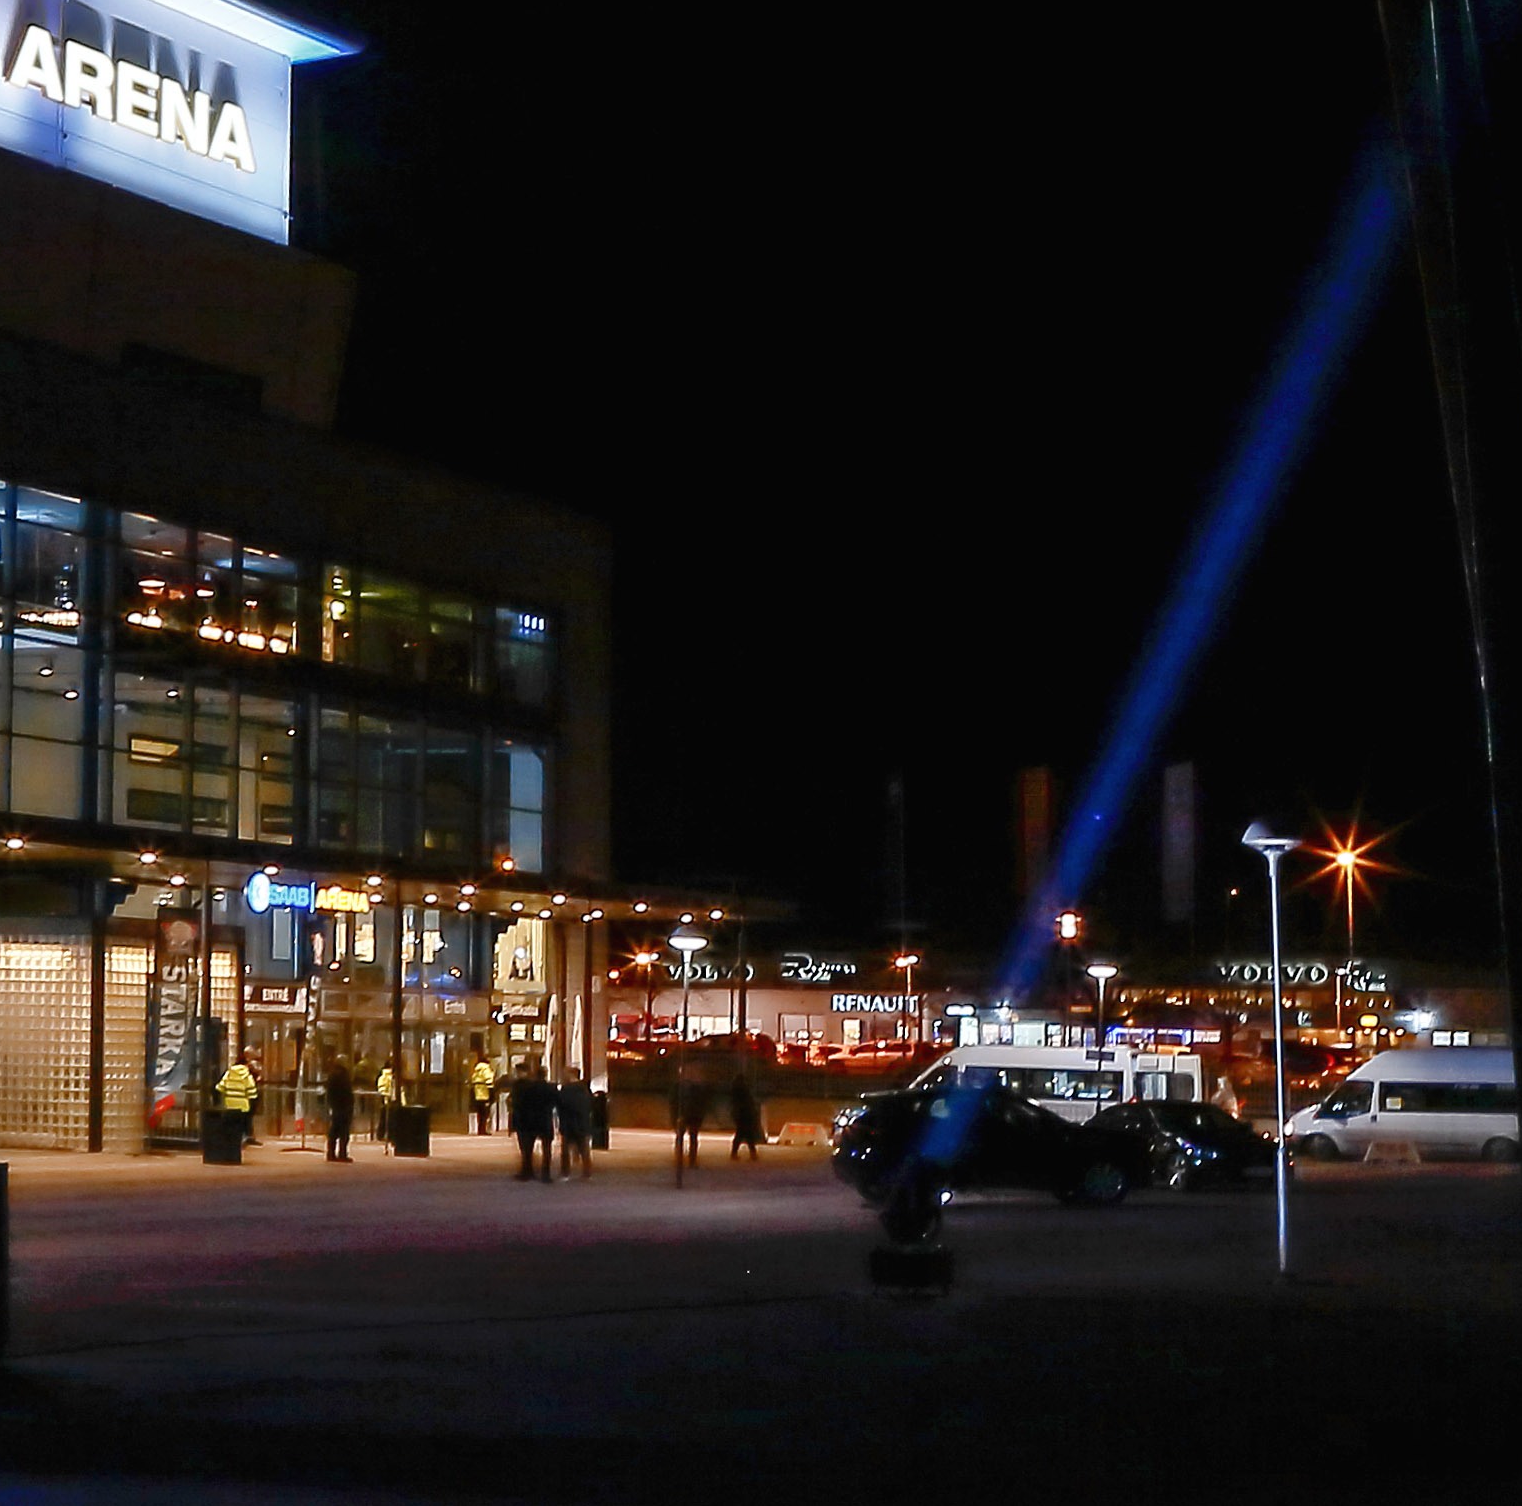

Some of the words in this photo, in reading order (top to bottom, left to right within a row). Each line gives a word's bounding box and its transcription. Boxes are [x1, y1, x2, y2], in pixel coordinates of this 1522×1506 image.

[6, 23, 256, 173] ARENA
[269, 884, 309, 907] SAAB
[315, 888, 370, 913] ARENA
[831, 994, 920, 1013] RENAULT
